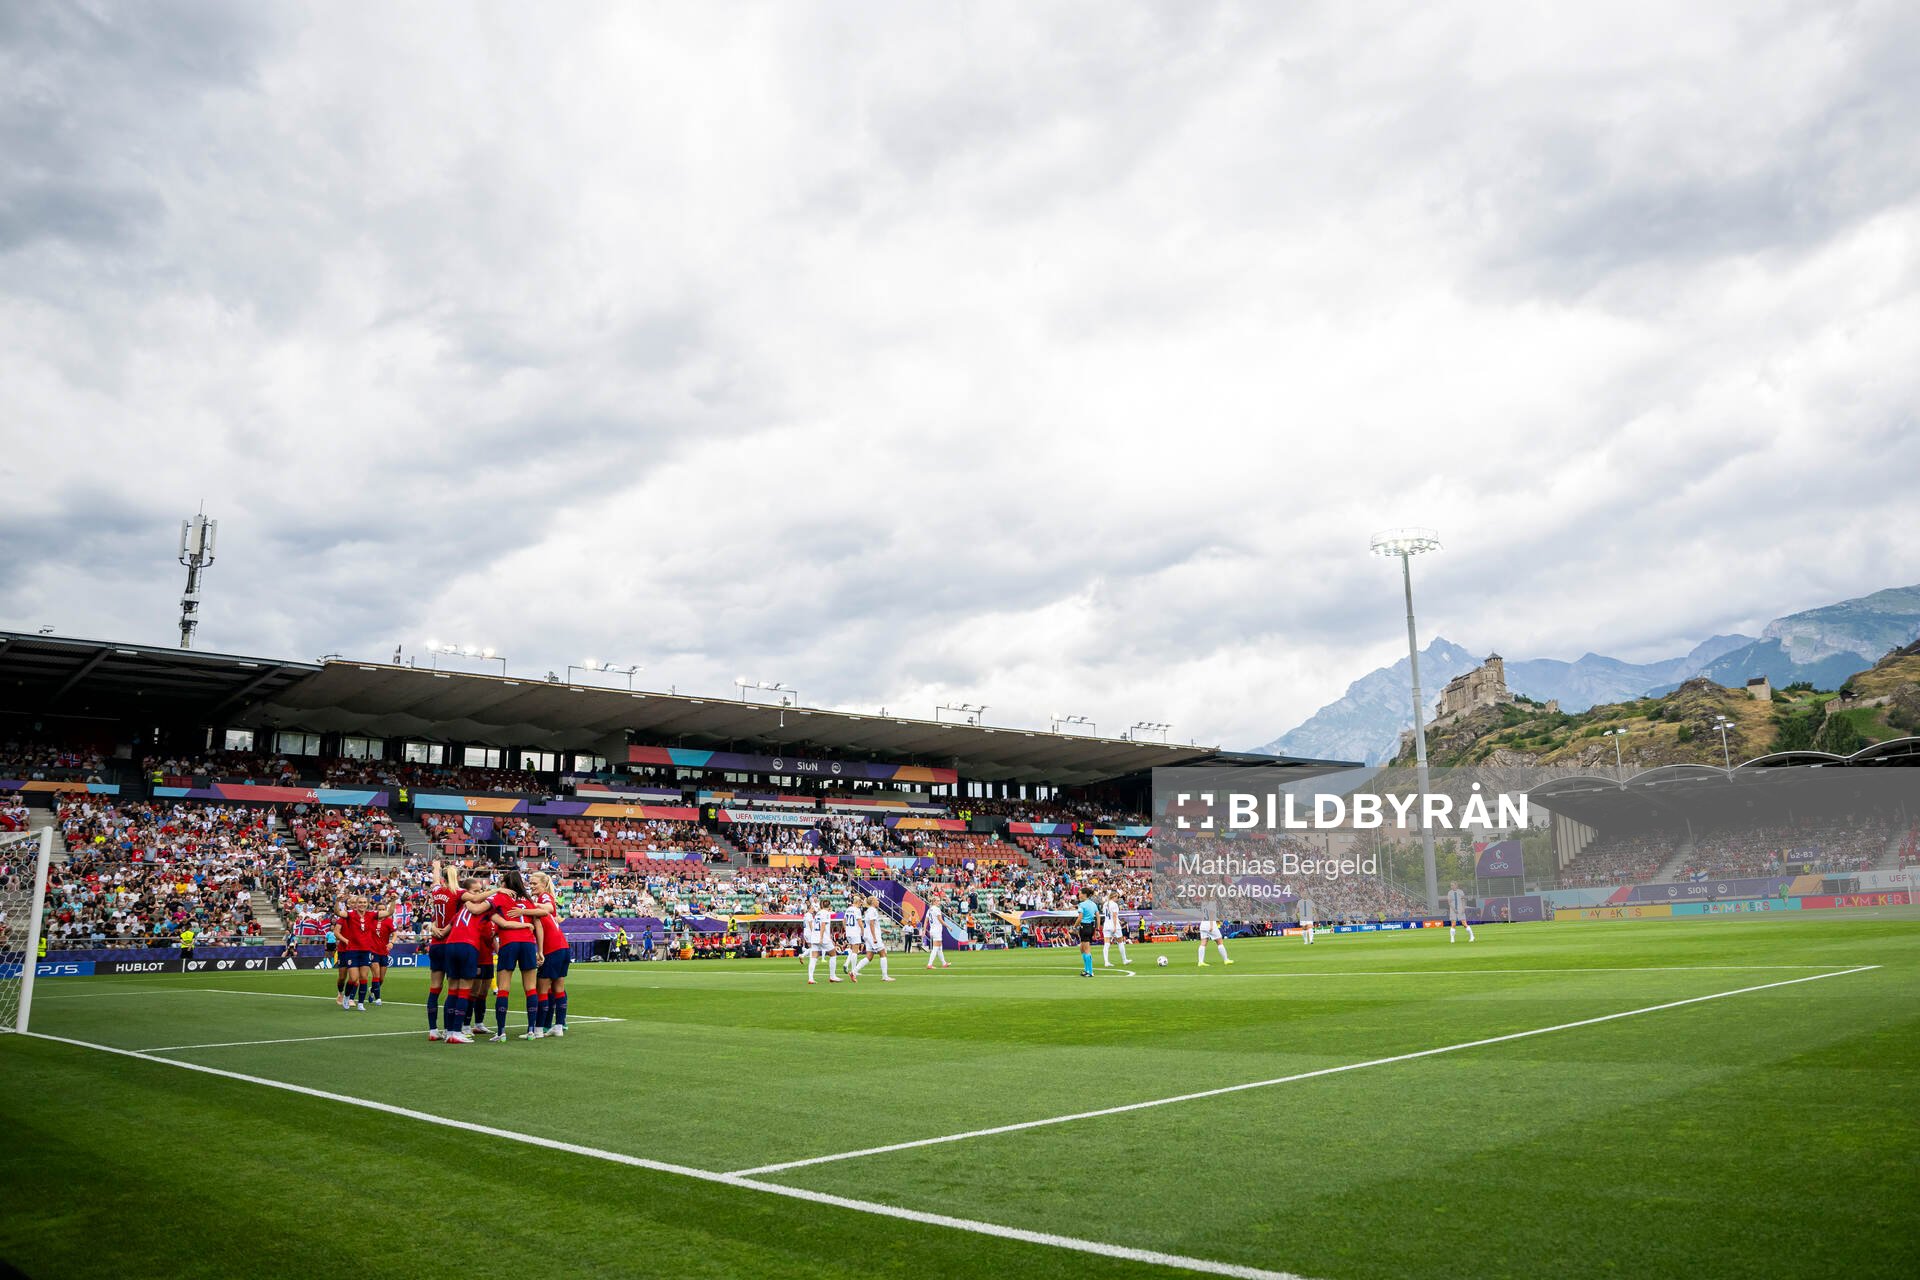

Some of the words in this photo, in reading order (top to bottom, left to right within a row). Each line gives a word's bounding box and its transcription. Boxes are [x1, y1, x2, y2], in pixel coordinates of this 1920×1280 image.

[797, 762, 818, 771] SION
[1688, 886, 1708, 895] SION
[1703, 901, 1770, 914] PLAYMAKERS
[37, 964, 80, 975] PS5
[115, 962, 164, 973] HUBLOT
